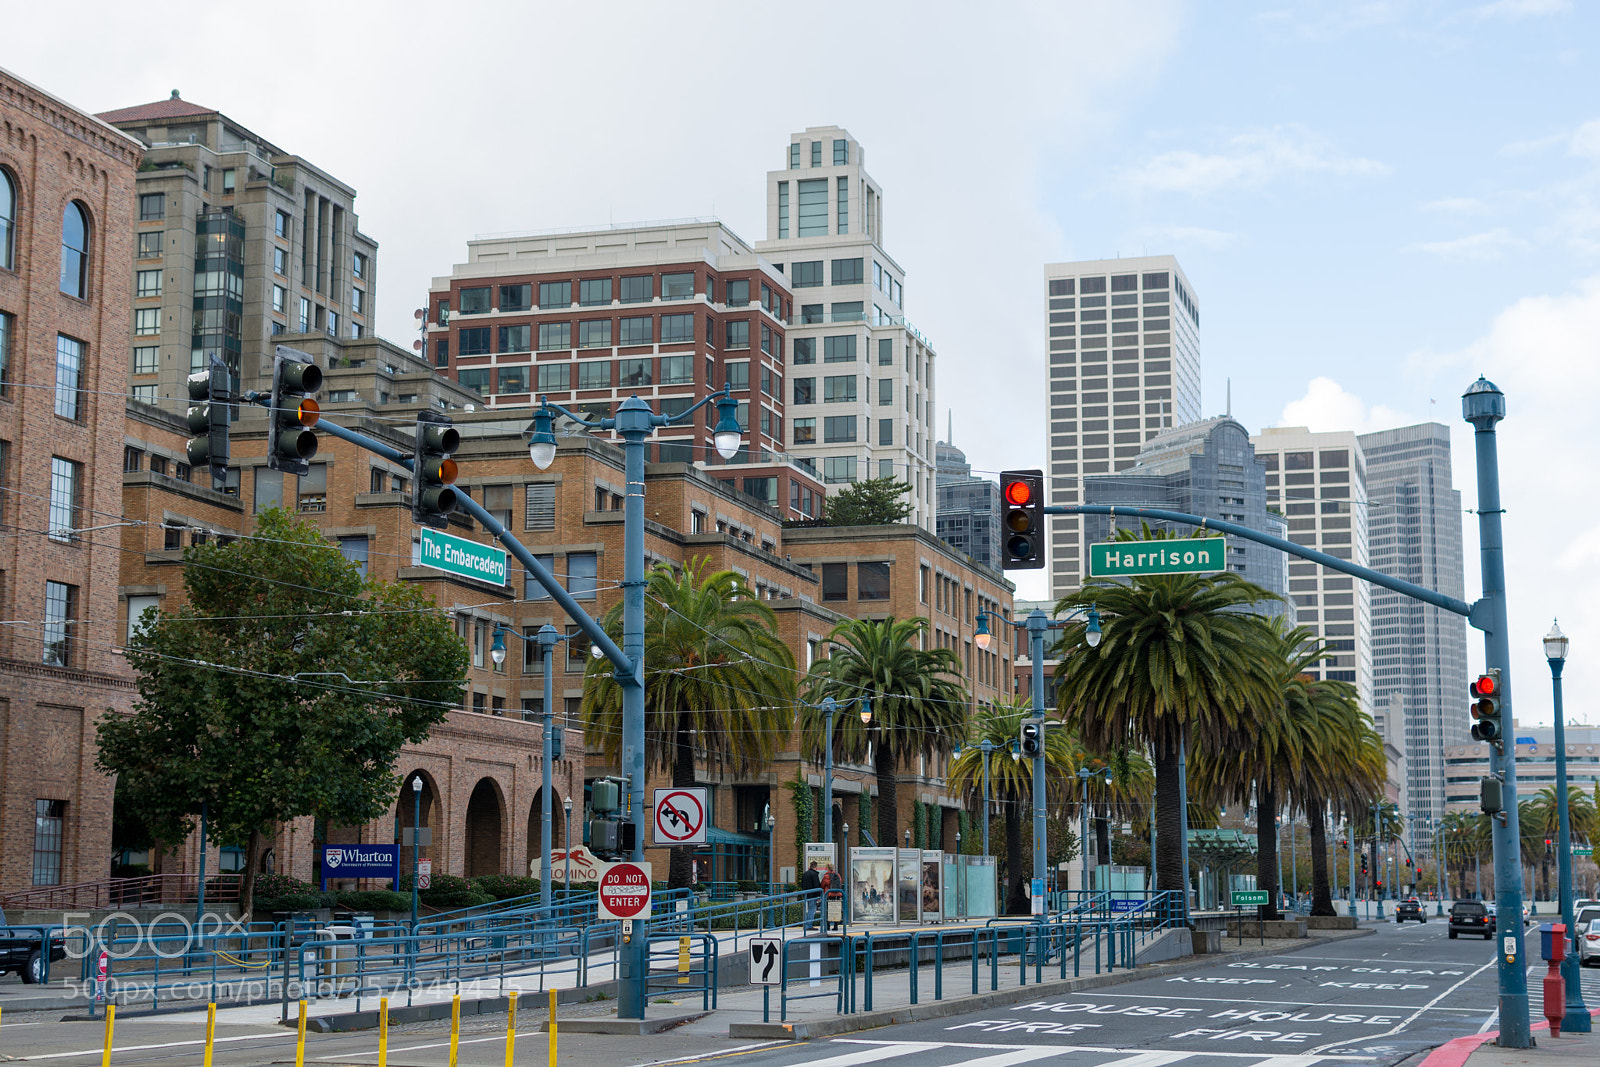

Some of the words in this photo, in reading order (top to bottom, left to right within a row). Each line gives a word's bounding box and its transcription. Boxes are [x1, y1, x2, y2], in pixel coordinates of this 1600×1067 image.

[424, 537, 441, 559] The
[444, 543, 504, 577] Embarcadero
[1105, 549, 1209, 568] Harrison
[343, 849, 392, 862] Wharton
[538, 868, 598, 880] LOMINO
[608, 875, 620, 883] DO
[626, 874, 643, 883] NOT
[610, 897, 640, 906] ENTER
[1227, 962, 1342, 971] CLEAR
[1351, 967, 1464, 976] CLEAR
[1318, 981, 1430, 990] KEEP
[1010, 1001, 1203, 1018] HOUSE
[1208, 1009, 1402, 1025] HOUSE
[943, 1019, 1104, 1035] FIRE
[1169, 1028, 1323, 1043] FIRE
